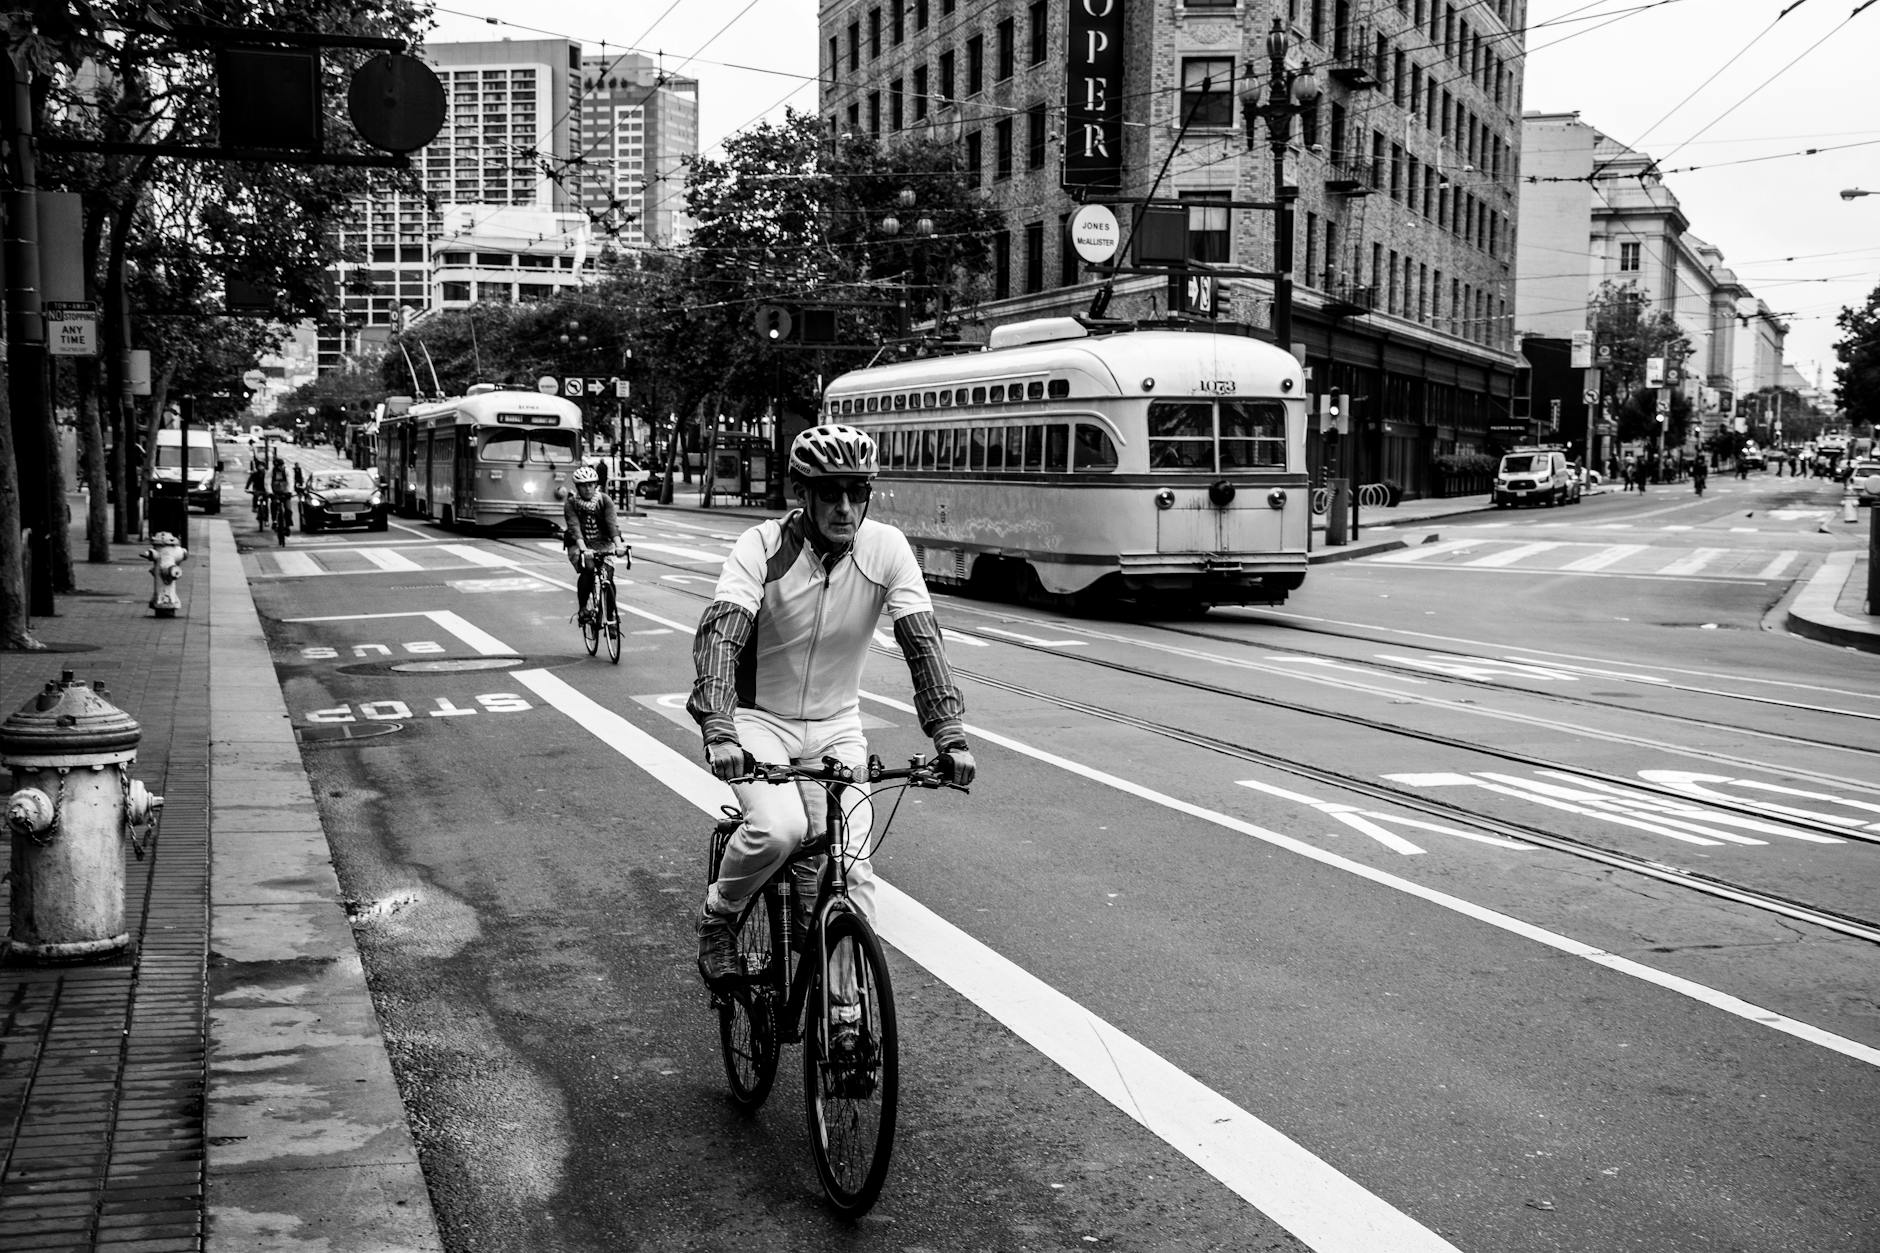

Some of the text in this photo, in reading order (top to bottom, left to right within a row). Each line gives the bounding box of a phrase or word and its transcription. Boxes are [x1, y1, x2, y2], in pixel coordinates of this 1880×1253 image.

[1082, 222, 1110, 231] JONES
[48, 310, 63, 321] NO
[62, 326, 83, 334] ANY
[60, 336, 86, 345] TIME
[302, 641, 446, 658] BUS
[305, 692, 534, 723] STOP
